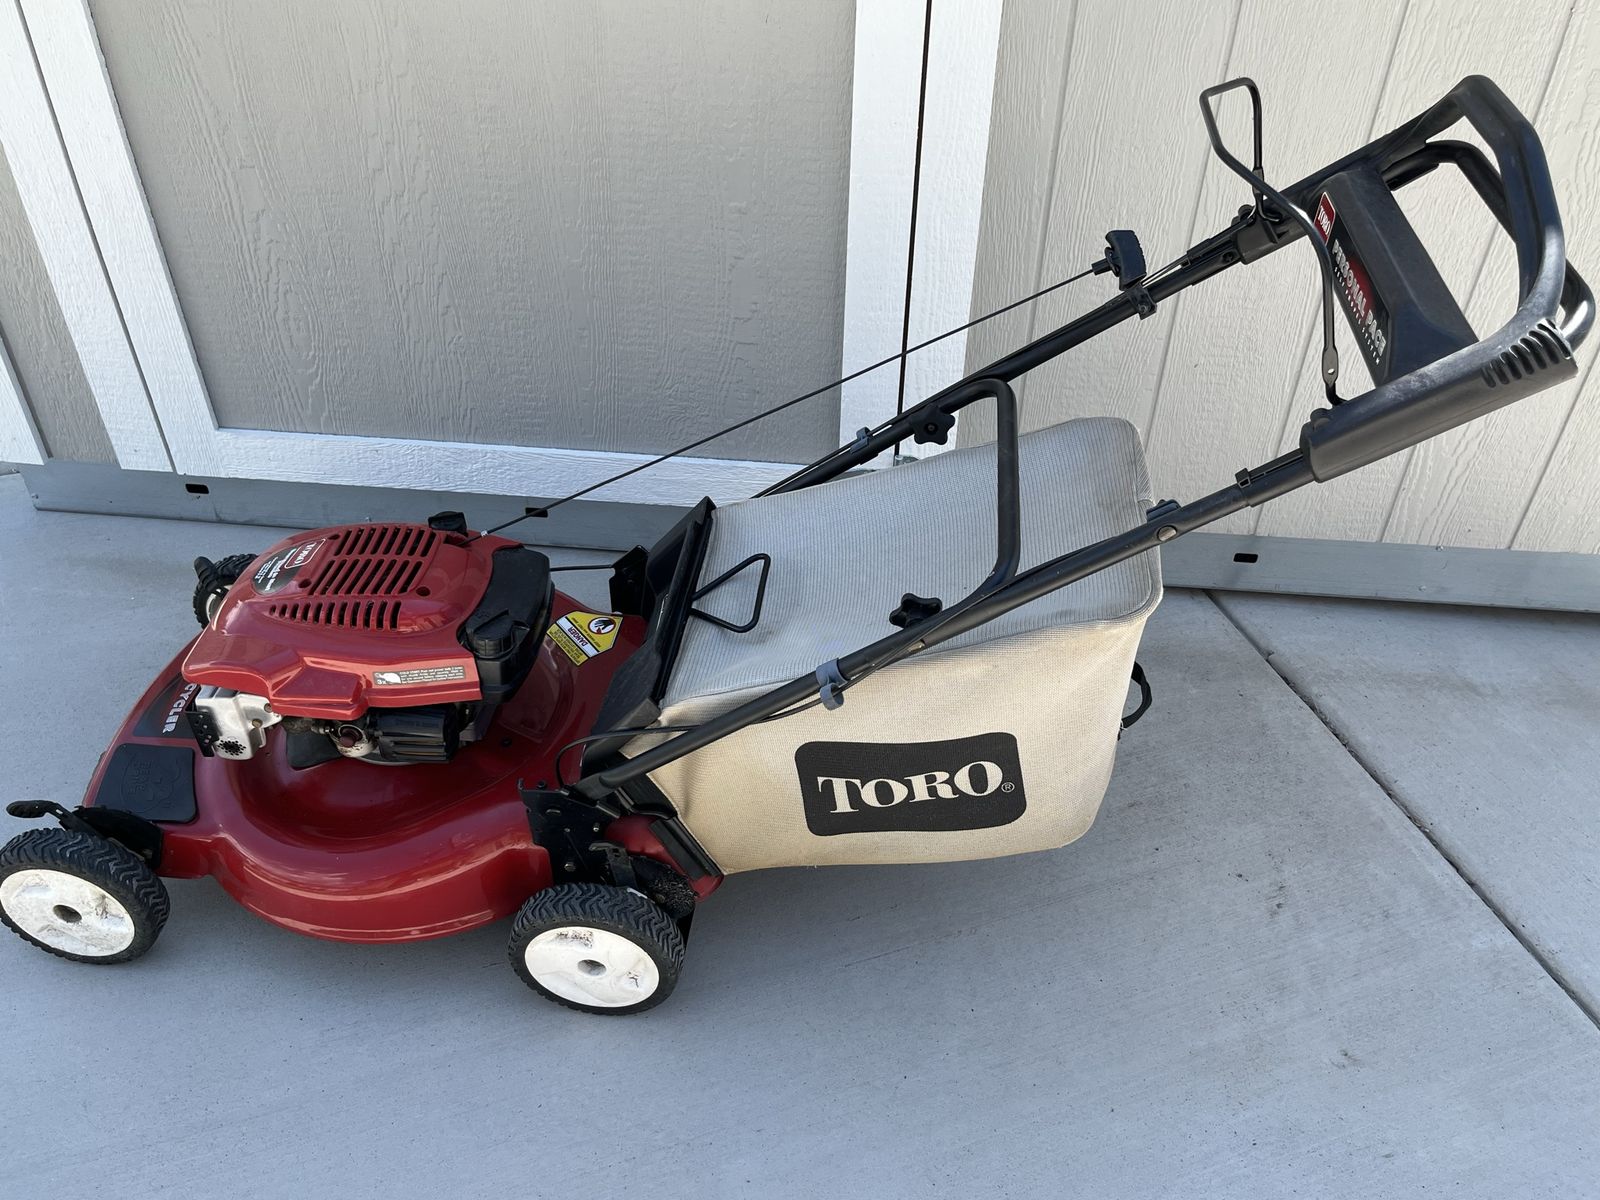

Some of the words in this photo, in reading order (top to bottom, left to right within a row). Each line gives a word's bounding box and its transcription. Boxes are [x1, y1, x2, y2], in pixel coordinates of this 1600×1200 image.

[1317, 205, 1331, 235] TORO
[1332, 239, 1367, 317] PERSONAL
[1365, 309, 1387, 357] PACE
[567, 626, 588, 647] DANGER
